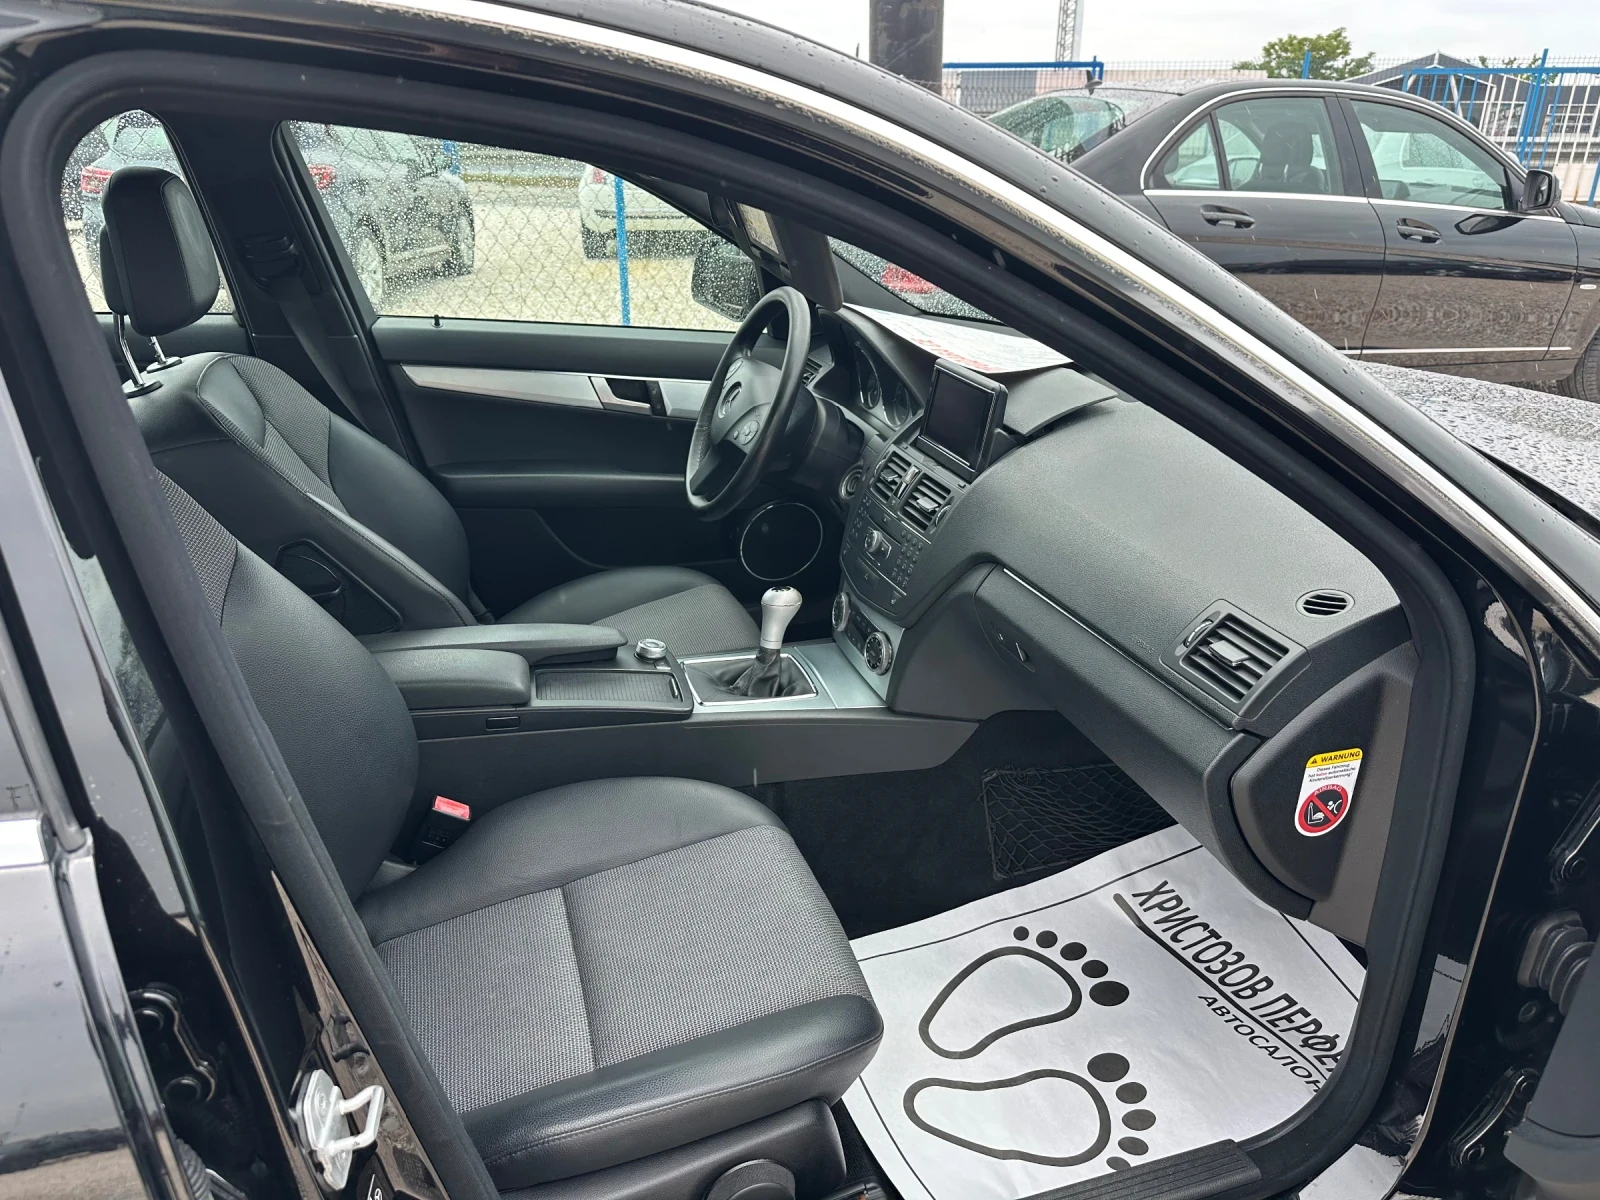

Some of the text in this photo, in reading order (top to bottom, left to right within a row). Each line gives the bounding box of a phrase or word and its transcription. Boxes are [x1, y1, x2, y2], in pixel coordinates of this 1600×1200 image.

[1321, 751, 1360, 762] WARNUNG
[1314, 785, 1343, 795] AIRBAG
[1132, 880, 1342, 1072] ХРИСТОЗОВ ПЕРФЕ
[1197, 994, 1320, 1092] АВТОСАЛОН
